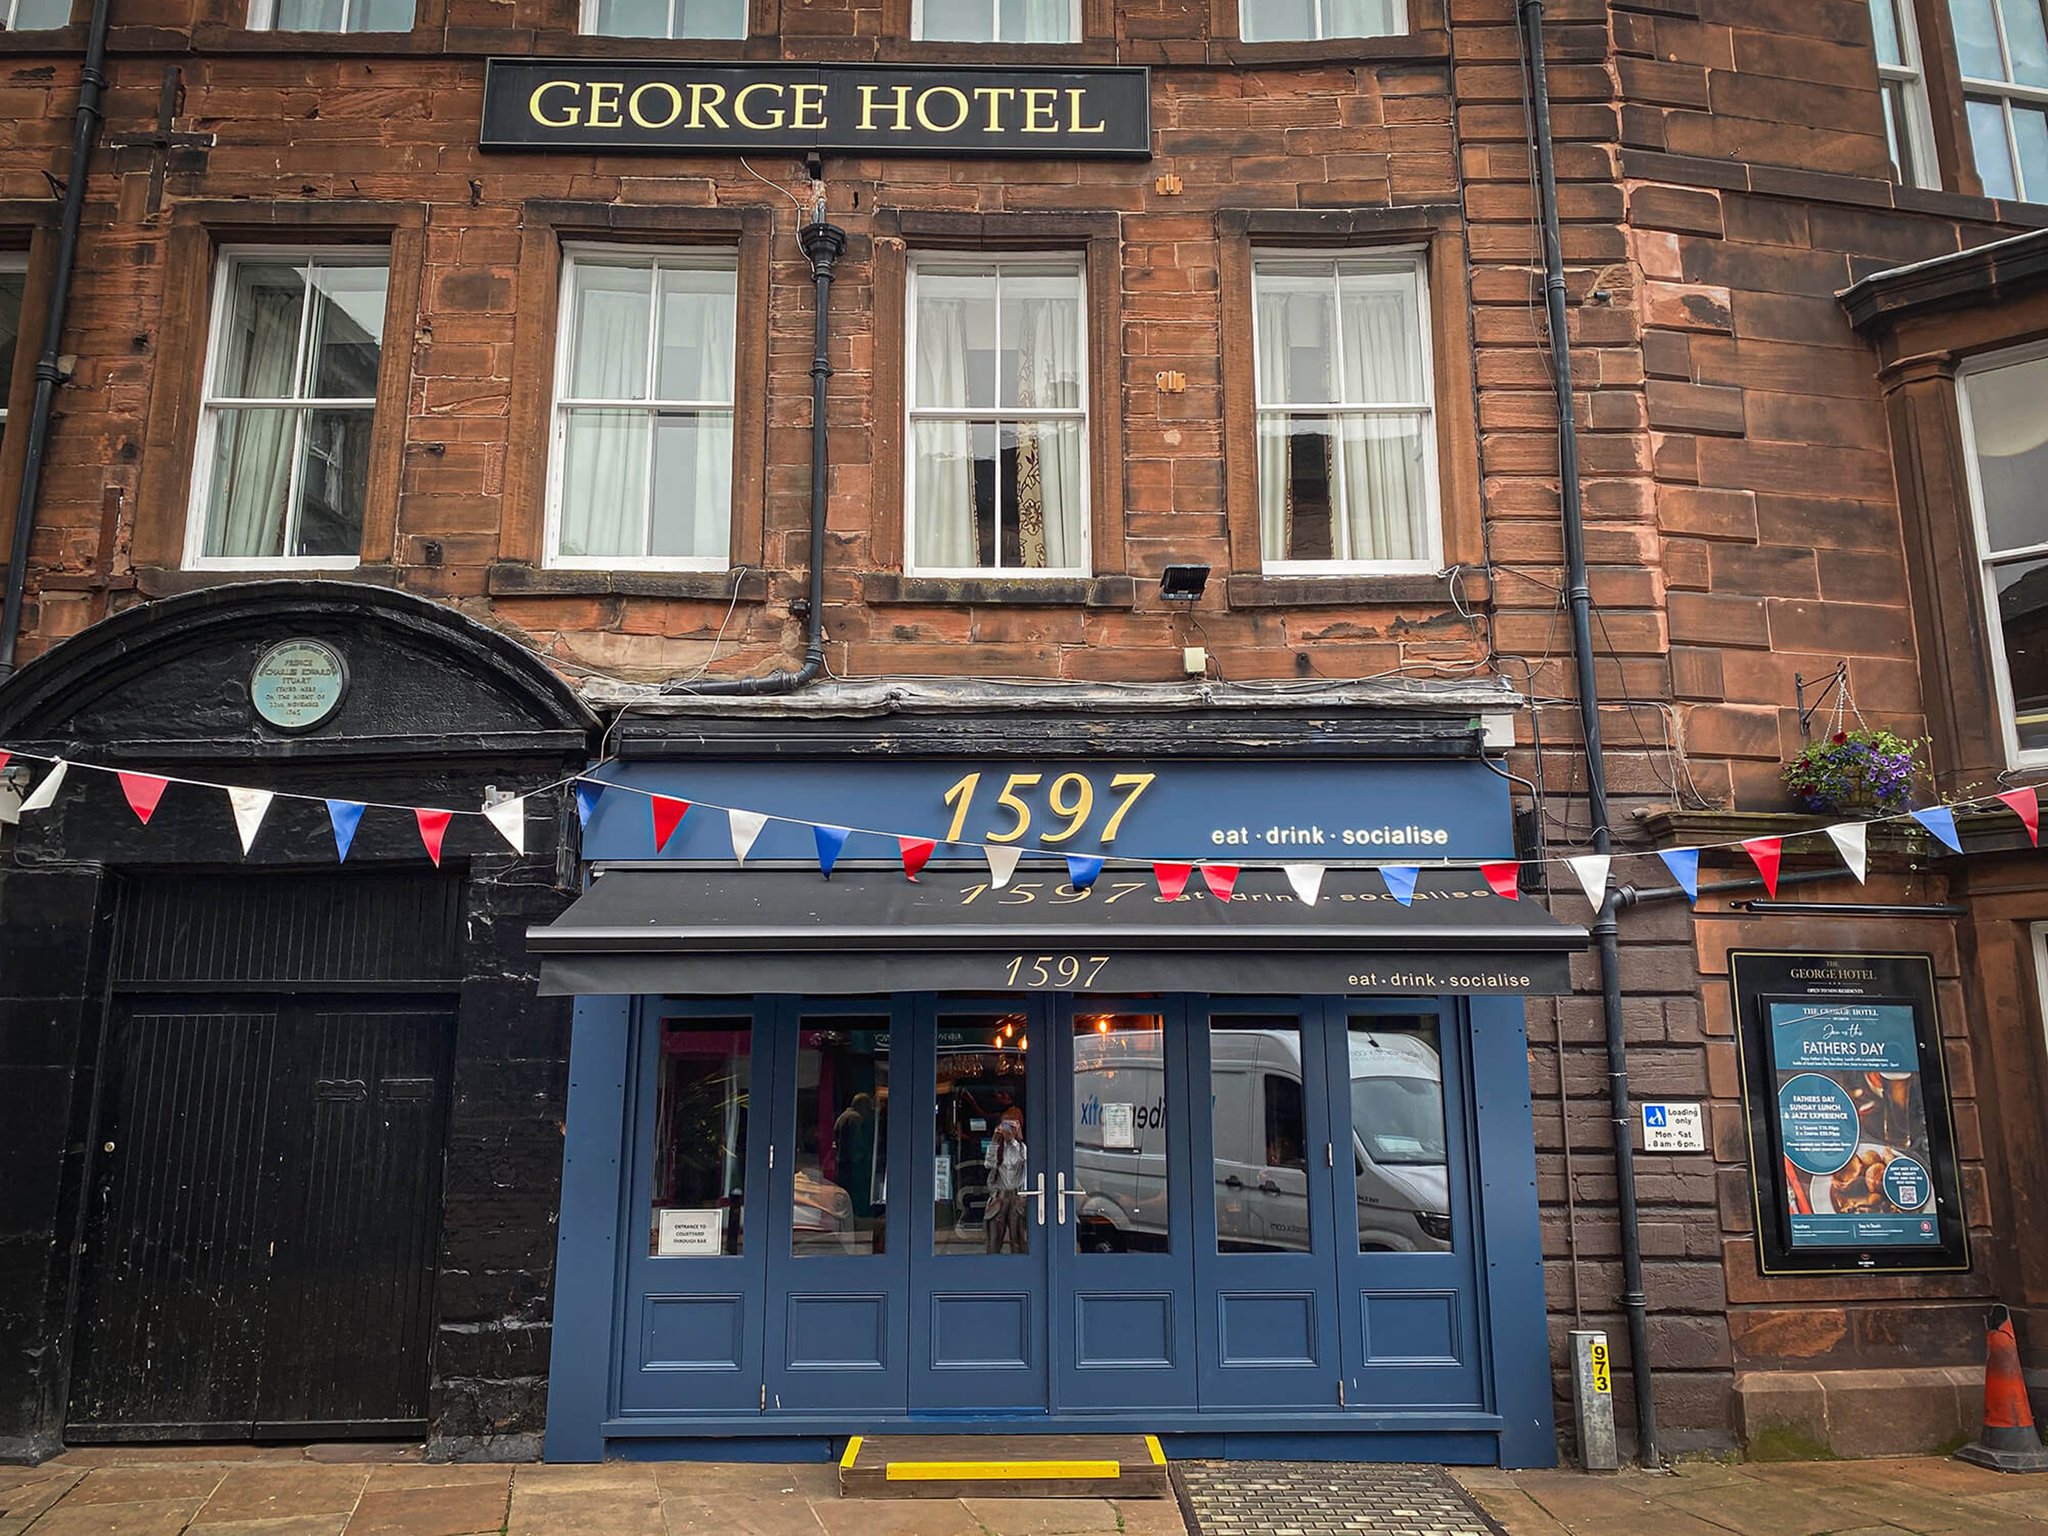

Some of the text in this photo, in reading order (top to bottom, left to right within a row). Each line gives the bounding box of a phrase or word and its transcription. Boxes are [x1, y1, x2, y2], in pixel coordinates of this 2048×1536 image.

[529, 81, 1106, 134] GEORGE HOTEL
[943, 772, 1156, 843] 1597
[1211, 826, 1449, 845] eat drink socialise
[960, 883, 1147, 905] 1597
[1230, 891, 1301, 902] drin
[1340, 889, 1490, 902] socalise
[1005, 955, 1111, 988] 1597
[1348, 972, 1531, 987] eat drink socialise
[1790, 968, 1877, 980] GEORGE HOTEL
[1803, 1041, 1885, 1055] FATHERS DAY
[1668, 1108, 1698, 1117] Loading
[1594, 1346, 1608, 1391] 973
